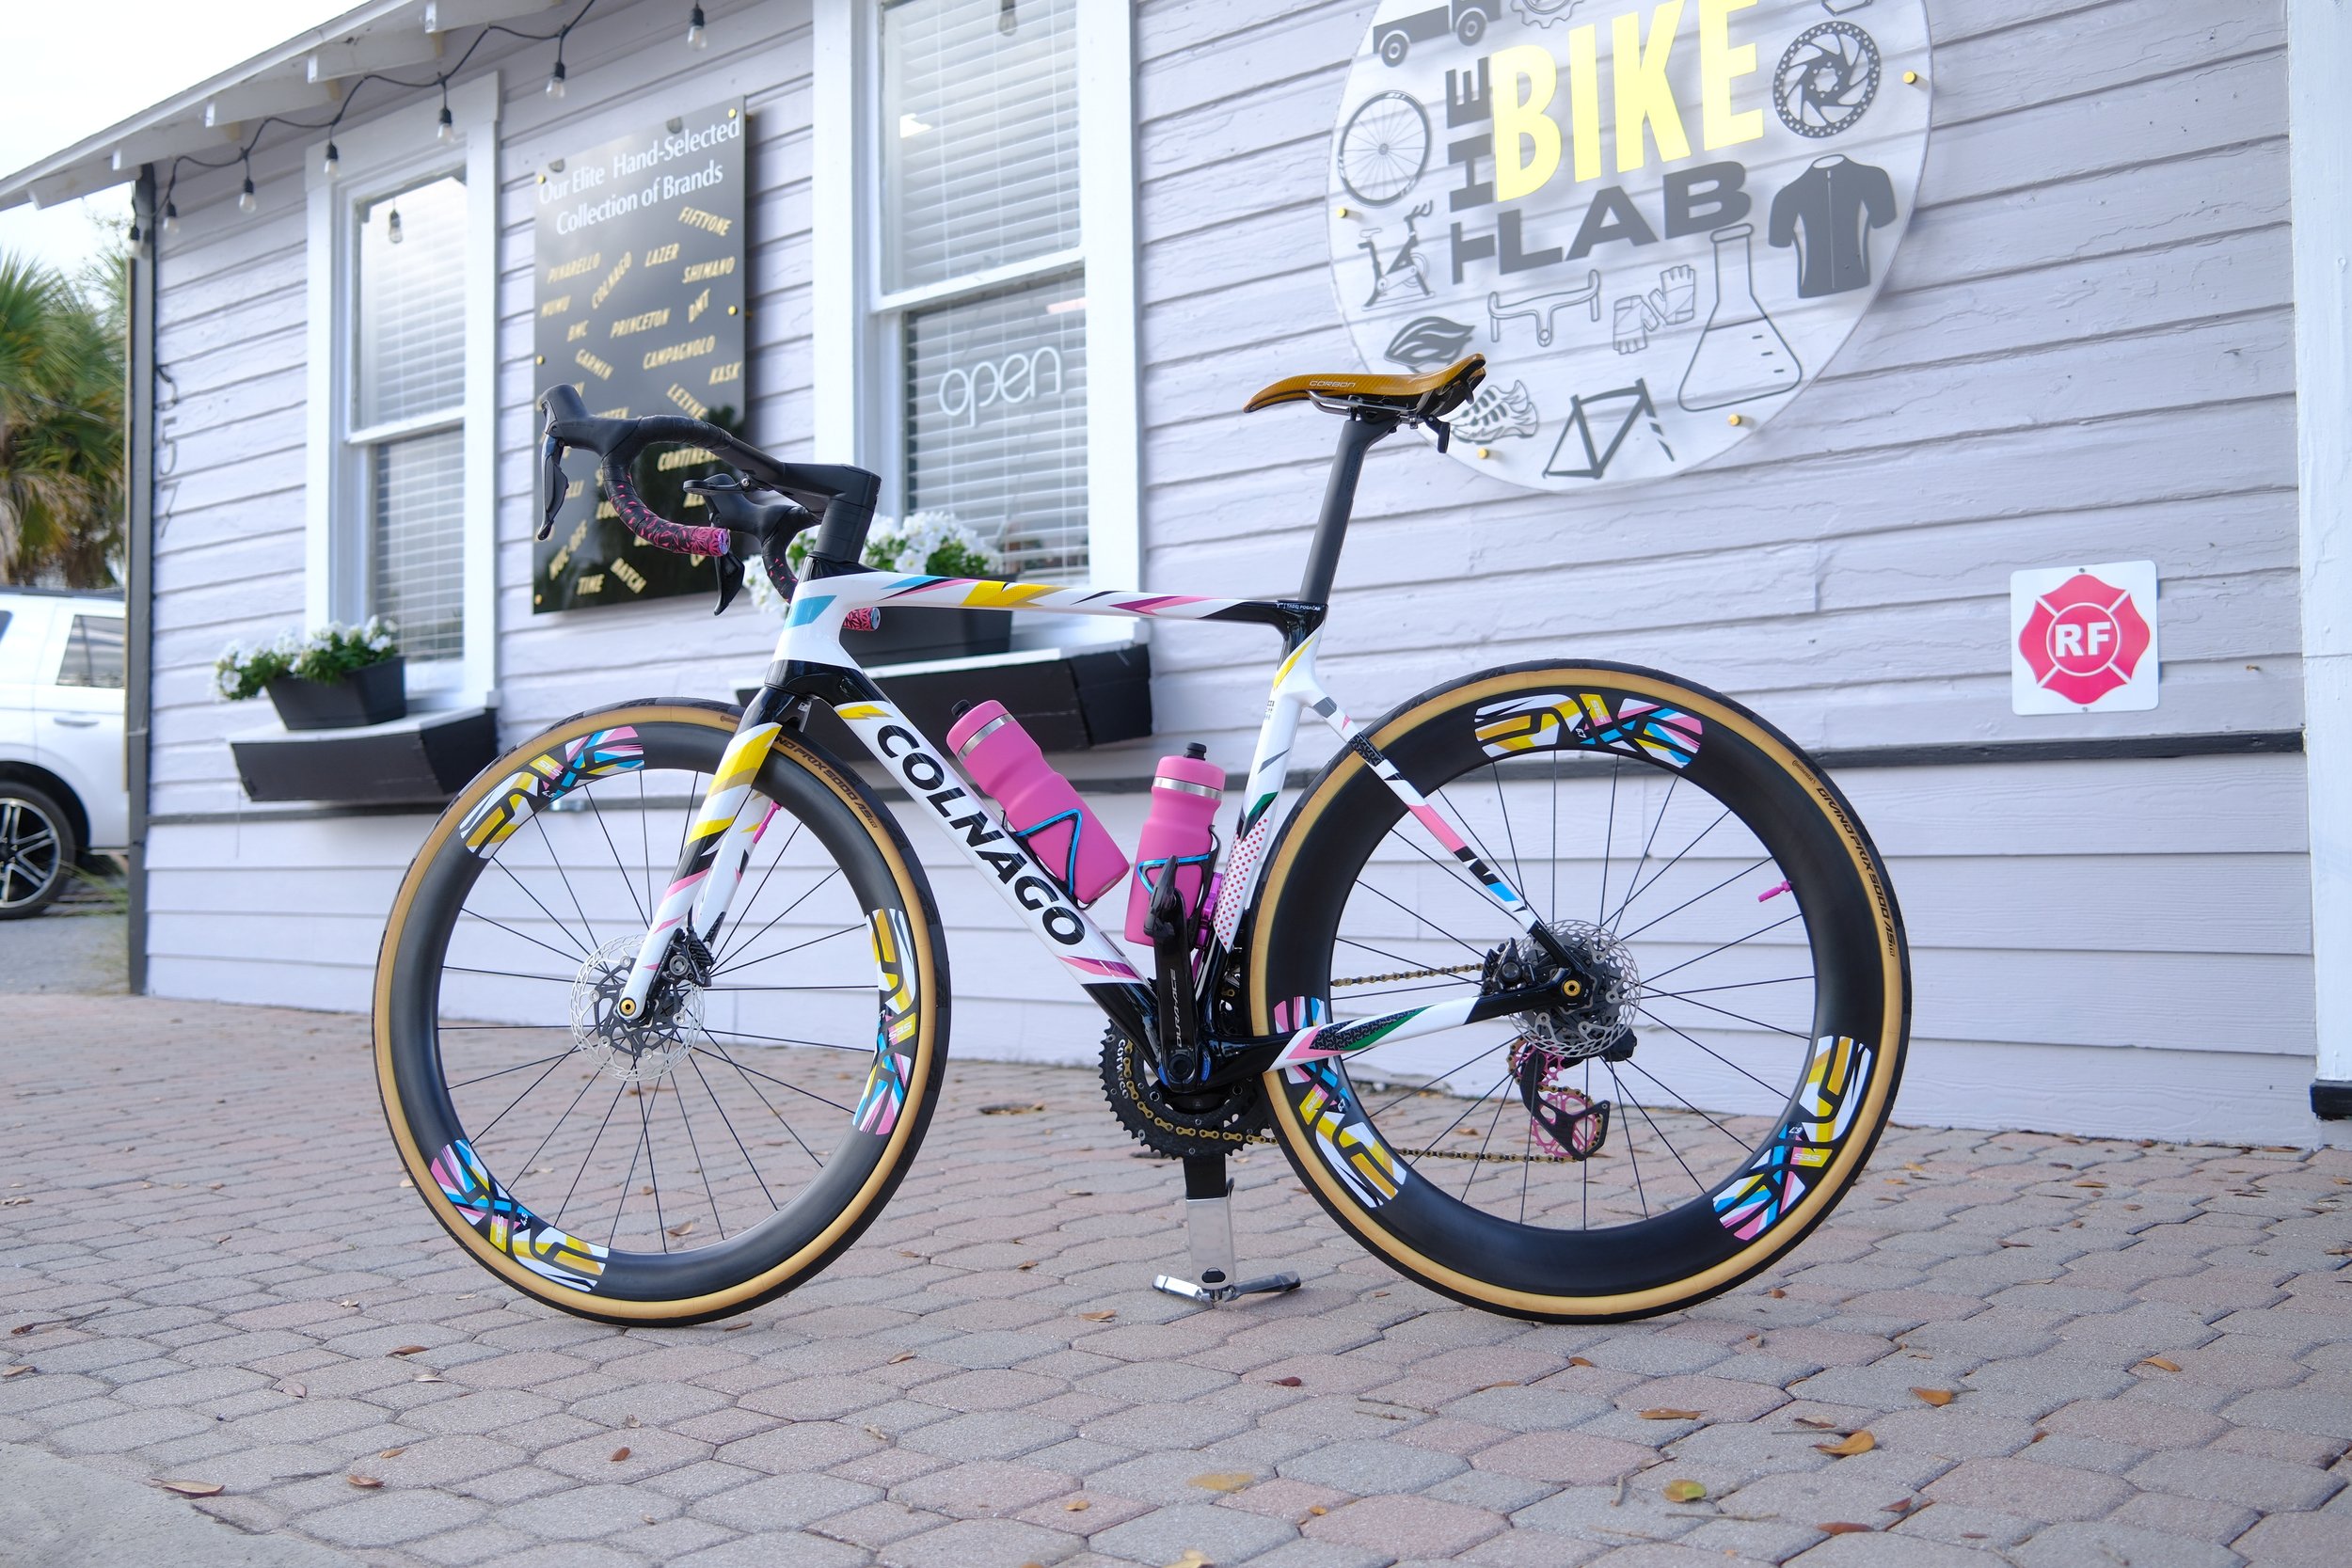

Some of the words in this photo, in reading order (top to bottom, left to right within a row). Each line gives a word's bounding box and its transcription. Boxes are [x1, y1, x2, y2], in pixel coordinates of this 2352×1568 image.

[1491, 0, 1764, 202] BIKE
[539, 180, 570, 204] Our
[572, 166, 605, 194] Elite
[613, 116, 740, 179] Hand-Selected
[1445, 55, 1497, 285] THE
[556, 194, 638, 235] Collection
[642, 177, 661, 207] of
[663, 159, 723, 200] Brands
[1497, 161, 1753, 276] LAB
[644, 243, 679, 267] LAZER
[682, 255, 736, 284] SHIMANO
[610, 308, 671, 339] PRINCETON
[575, 348, 614, 381] GARMIN
[643, 335, 716, 370] CAMPAGNOLO
[708, 361, 742, 385] KASK
[666, 383, 708, 420] LEZYNE
[939, 346, 1061, 428] open
[2055, 621, 2111, 657] RF
[877, 724, 1086, 945] COLNAGO
[1868, 873, 1890, 919] 5000
[1169, 968, 1183, 1048] DURA-ACE
